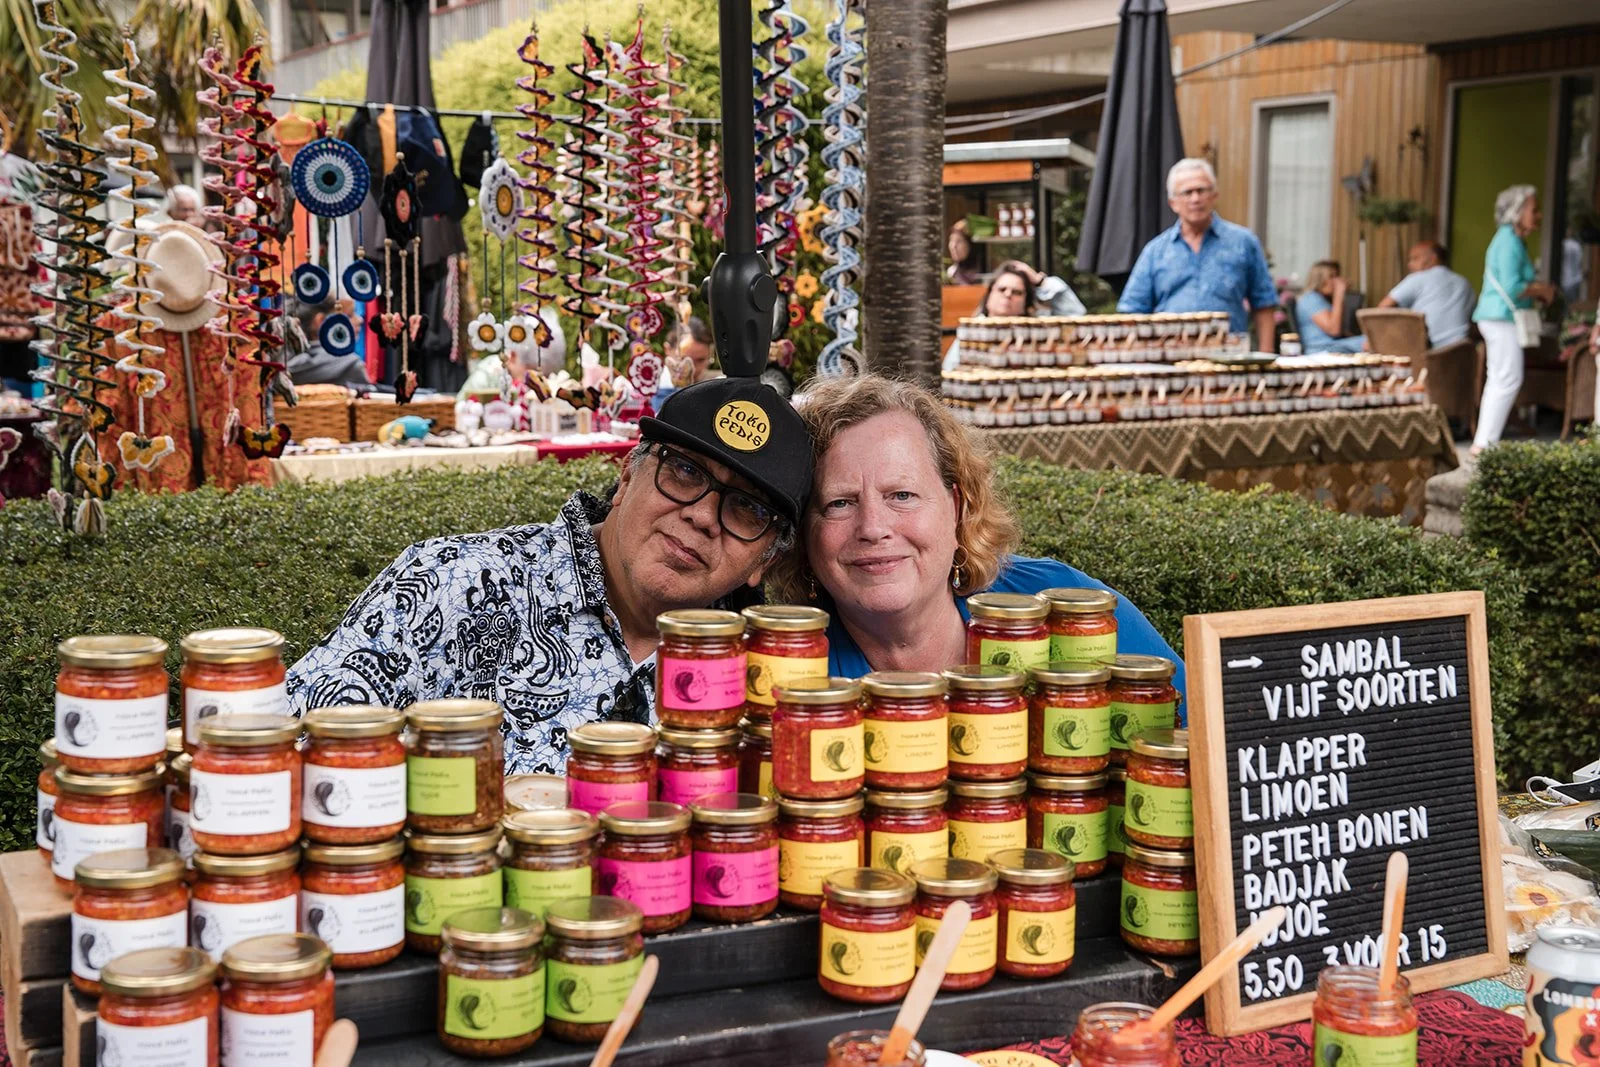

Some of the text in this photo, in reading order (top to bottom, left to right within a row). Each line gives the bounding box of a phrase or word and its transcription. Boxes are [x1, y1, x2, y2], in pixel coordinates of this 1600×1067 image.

[727, 404, 767, 434] TOKO
[1300, 635, 1411, 679] SAMBAL
[1262, 664, 1457, 721] VIJF SOORTEN
[1238, 732, 1367, 784] KLAPPER
[1240, 771, 1349, 822] LIMOEN
[1243, 806, 1428, 871] PETEH BONEN
[1243, 857, 1351, 910] BADJAK
[1244, 954, 1304, 1000] 5.50
[1343, 934, 1411, 968] VOR
[1418, 924, 1447, 962] 15
